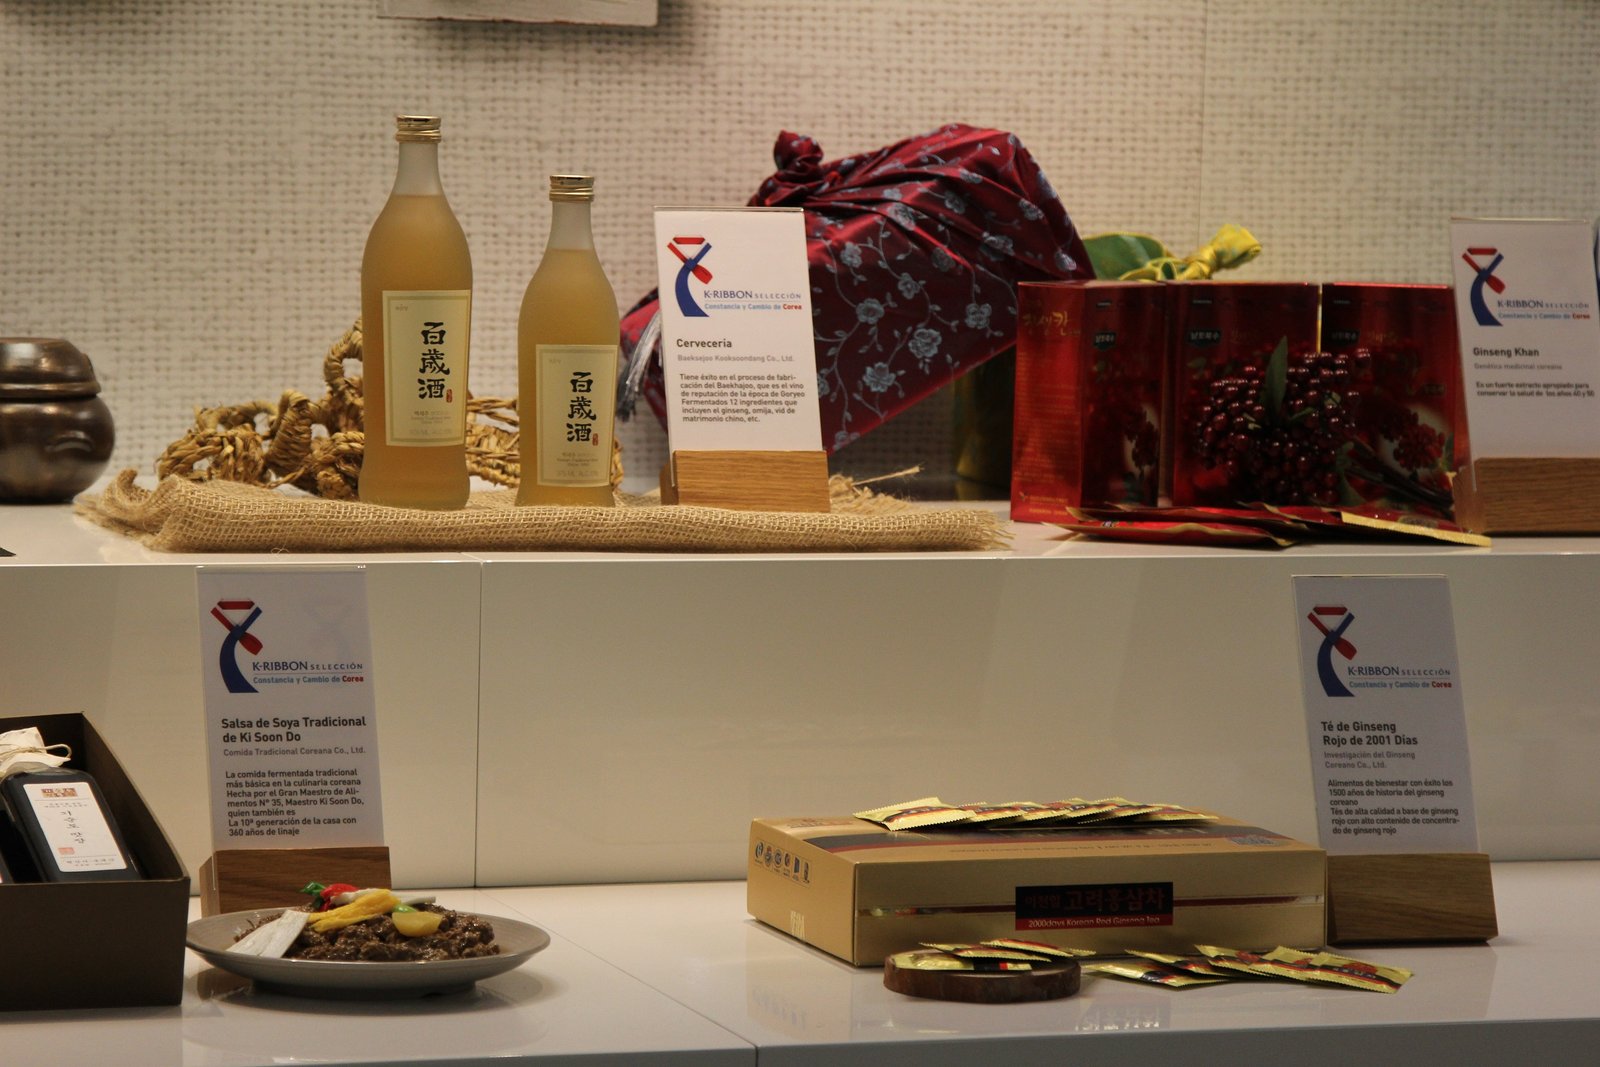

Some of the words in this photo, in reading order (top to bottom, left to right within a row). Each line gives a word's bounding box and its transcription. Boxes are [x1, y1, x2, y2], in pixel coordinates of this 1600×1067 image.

[704, 290, 753, 299] K-RIBBON
[1497, 300, 1544, 309] K-RIBBON
[1473, 347, 1512, 358] Ginseng
[1514, 347, 1539, 357] Khan
[691, 390, 729, 398] reputación
[780, 390, 806, 398] Goryeo
[682, 398, 728, 406] Fermentados
[682, 407, 712, 415] incluyen
[752, 407, 774, 415] omija,
[252, 661, 308, 671] K-RIBBON
[1347, 666, 1400, 676] K-RIBBON
[1401, 668, 1451, 676] SELECCIÓN
[342, 675, 364, 683] Corea
[221, 718, 254, 729] Salsa
[256, 718, 270, 728] de
[272, 717, 300, 729] Soya
[302, 716, 366, 728] Tradicional
[1320, 721, 1334, 732] Té
[1336, 722, 1350, 732] de
[1352, 721, 1397, 734] Ginseng
[223, 733, 237, 743] de
[240, 732, 252, 743] Ki
[254, 732, 283, 743] Soon
[286, 731, 301, 742] Do
[1323, 735, 1348, 747] Rojo
[1349, 735, 1363, 746] de
[1366, 735, 1391, 746] 2001
[223, 748, 254, 756] Comida
[254, 748, 299, 756] Tradicional
[299, 747, 333, 755] Coreana
[333, 747, 349, 755] Co.,
[350, 746, 366, 754] Ltd.
[1324, 751, 1372, 760] Investigación
[1386, 751, 1416, 760] Ginseng
[225, 771, 236, 779] La
[237, 770, 267, 779] comida
[267, 769, 314, 778] fermentada
[315, 768, 358, 777] tradicional
[226, 780, 244, 788] más
[245, 780, 271, 788] básica
[293, 779, 328, 787] culinaria
[1328, 779, 1364, 787] Alimentos
[1375, 779, 1409, 787] bienestar
[1424, 779, 1442, 787] éxito
[1442, 779, 1453, 787] los
[227, 790, 252, 798] Hecha
[269, 789, 277, 797] el
[278, 789, 298, 797] Gran
[300, 788, 332, 796] Maestro
[334, 788, 344, 796] de
[1329, 788, 1346, 796] 1500
[1416, 789, 1445, 797] ginseng
[227, 800, 258, 808] mentos
[271, 799, 284, 807] 35,
[285, 798, 318, 806] Maestro
[351, 797, 364, 805] Do,
[227, 809, 251, 818] quien
[251, 808, 285, 817] también
[1330, 807, 1344, 816] Tés
[1430, 808, 1459, 816] ginseng
[228, 819, 239, 827] La
[256, 818, 300, 827] generación
[301, 817, 312, 825] de
[313, 817, 321, 825] la
[1331, 817, 1346, 825] rojo
[1361, 817, 1375, 825] alto
[229, 828, 244, 837] 360
[245, 827, 265, 836] años
[266, 828, 276, 836] de
[278, 827, 300, 836] linaje
[1353, 827, 1382, 835] ginseng
[1382, 826, 1397, 835] rojo
[1064, 887, 1165, 911] 고려홍삼차
[1028, 919, 1066, 928] 2000days
[1067, 918, 1095, 926] Korean
[1096, 917, 1111, 925] Red
